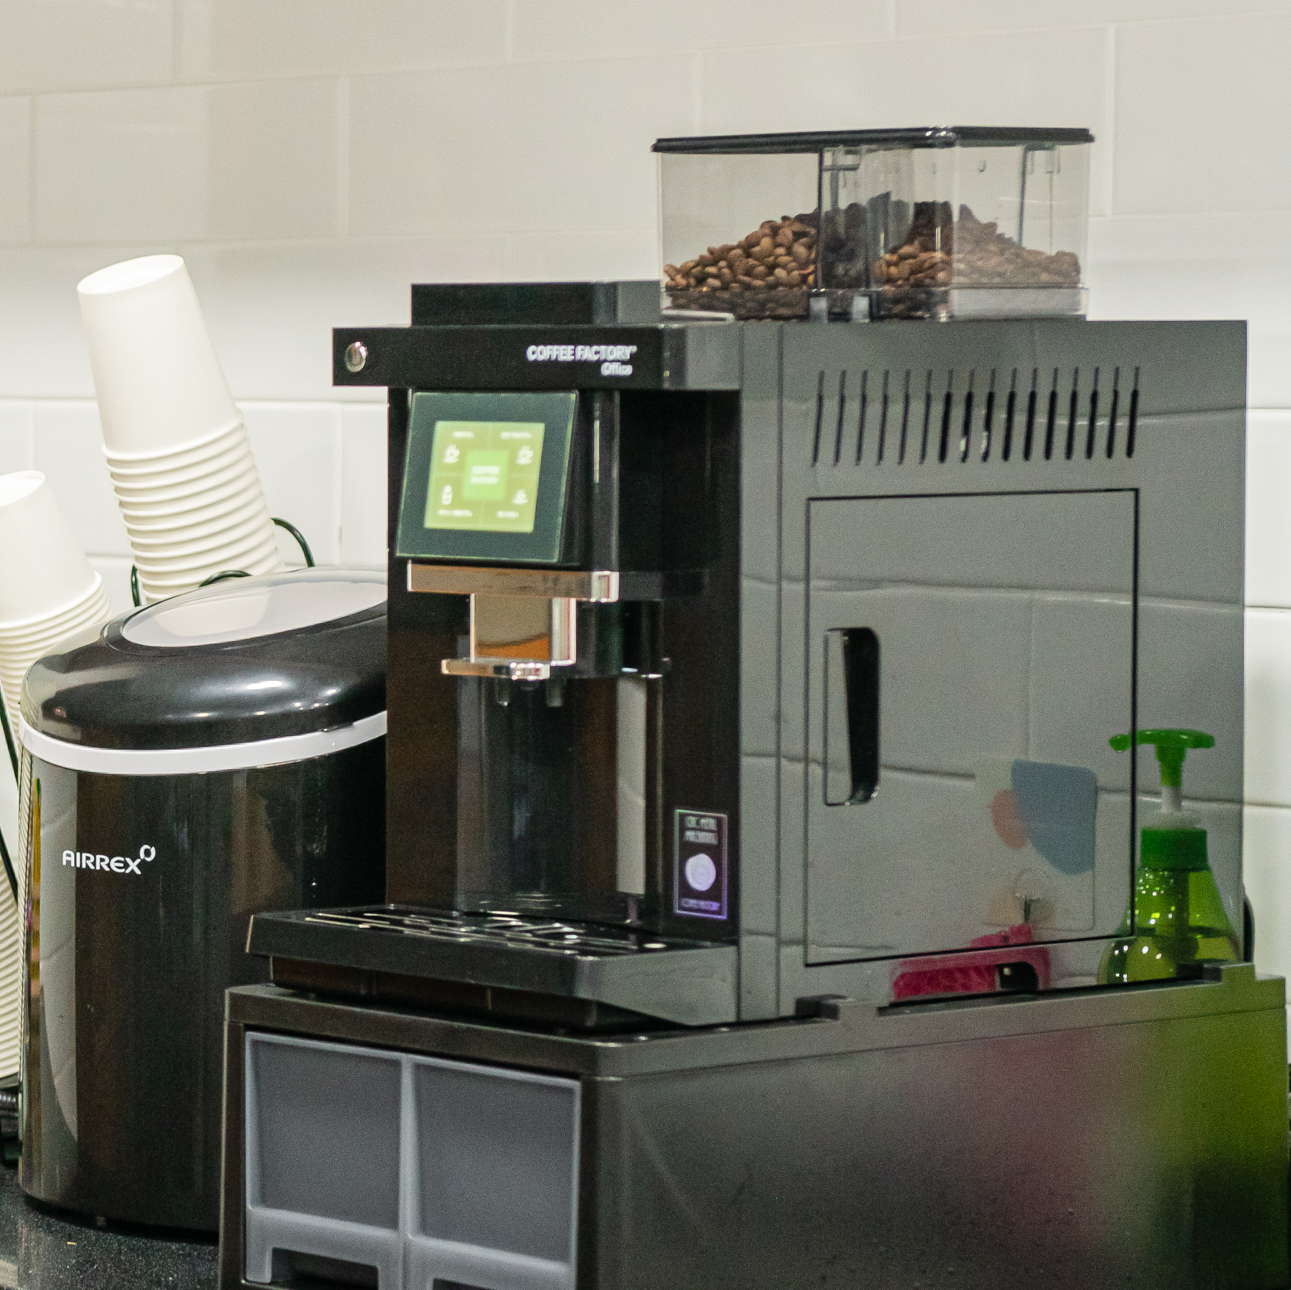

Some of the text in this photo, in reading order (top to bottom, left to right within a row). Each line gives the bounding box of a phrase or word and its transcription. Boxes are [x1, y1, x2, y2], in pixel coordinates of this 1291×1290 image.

[526, 345, 632, 361] COFFEE FACTORY
[62, 849, 142, 875] AIRREX
